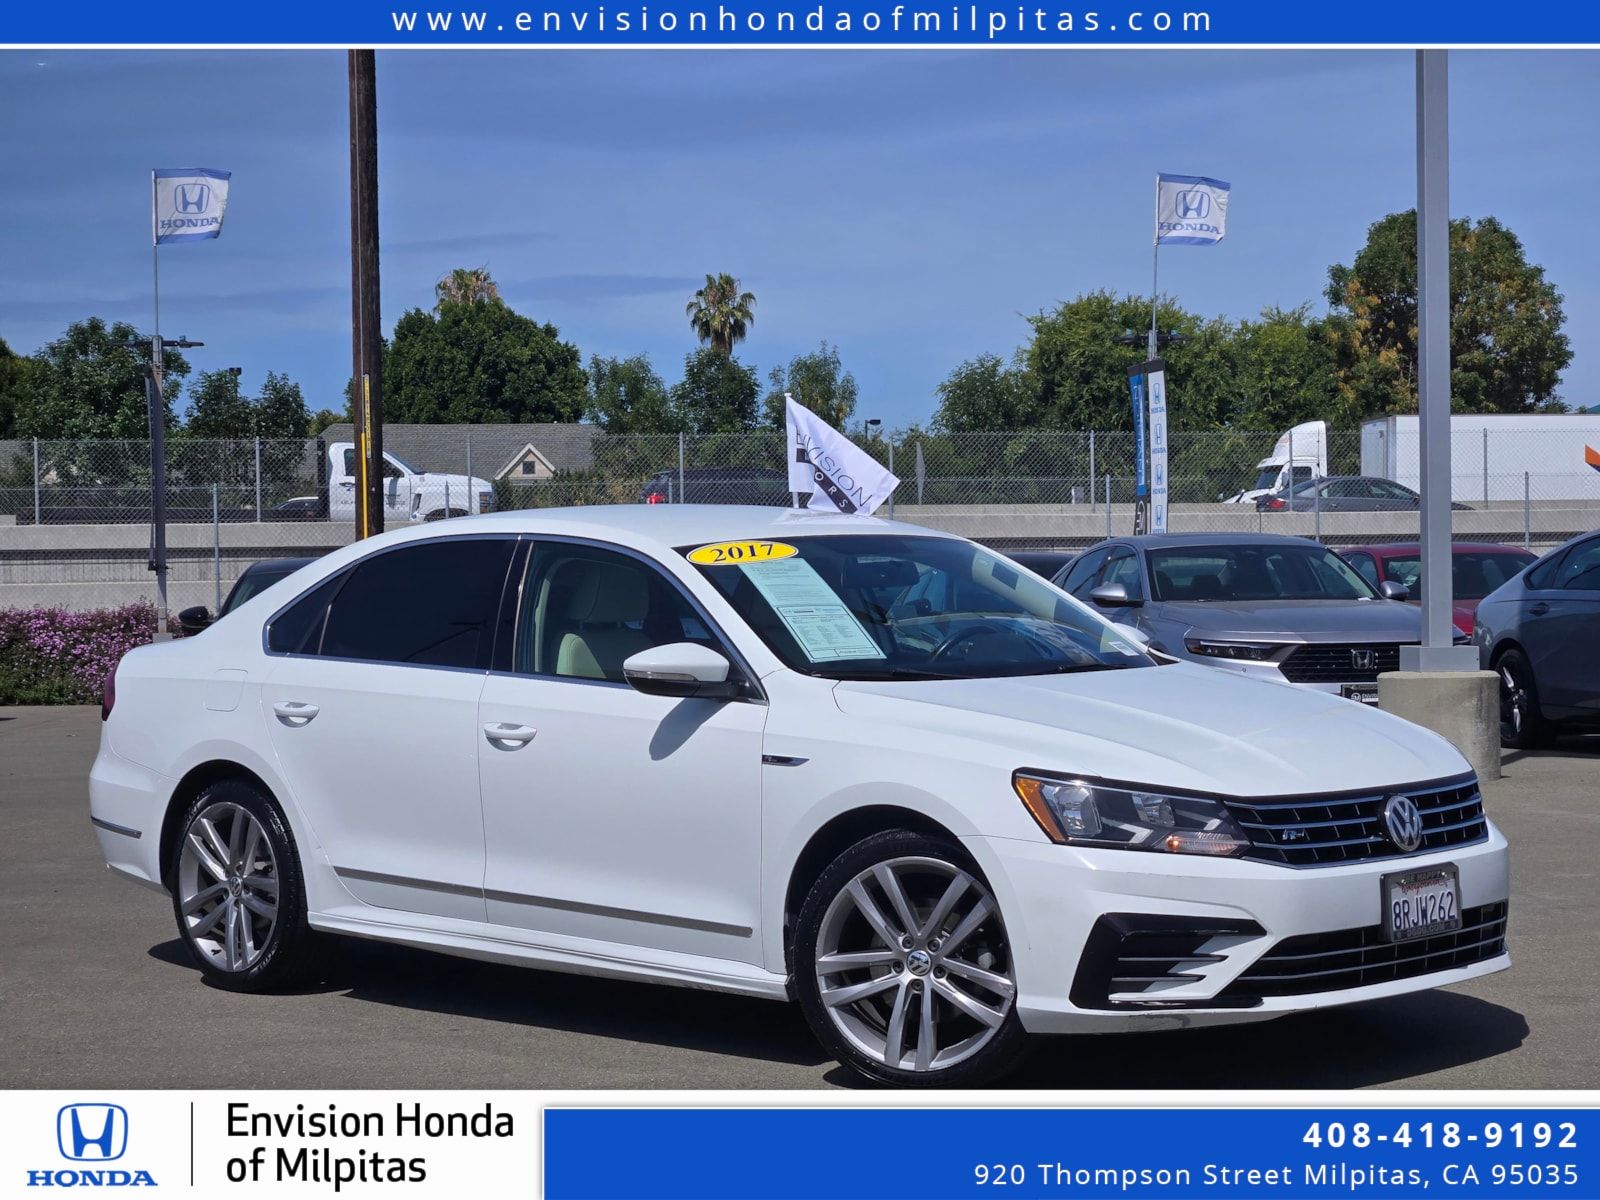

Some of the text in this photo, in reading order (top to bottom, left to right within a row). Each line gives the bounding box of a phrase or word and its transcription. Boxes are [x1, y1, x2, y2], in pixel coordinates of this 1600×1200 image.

[159, 216, 221, 229] HONDA
[1159, 221, 1221, 235] HONDA
[710, 543, 774, 563] 2017
[1393, 891, 1456, 930] 8RJW262
